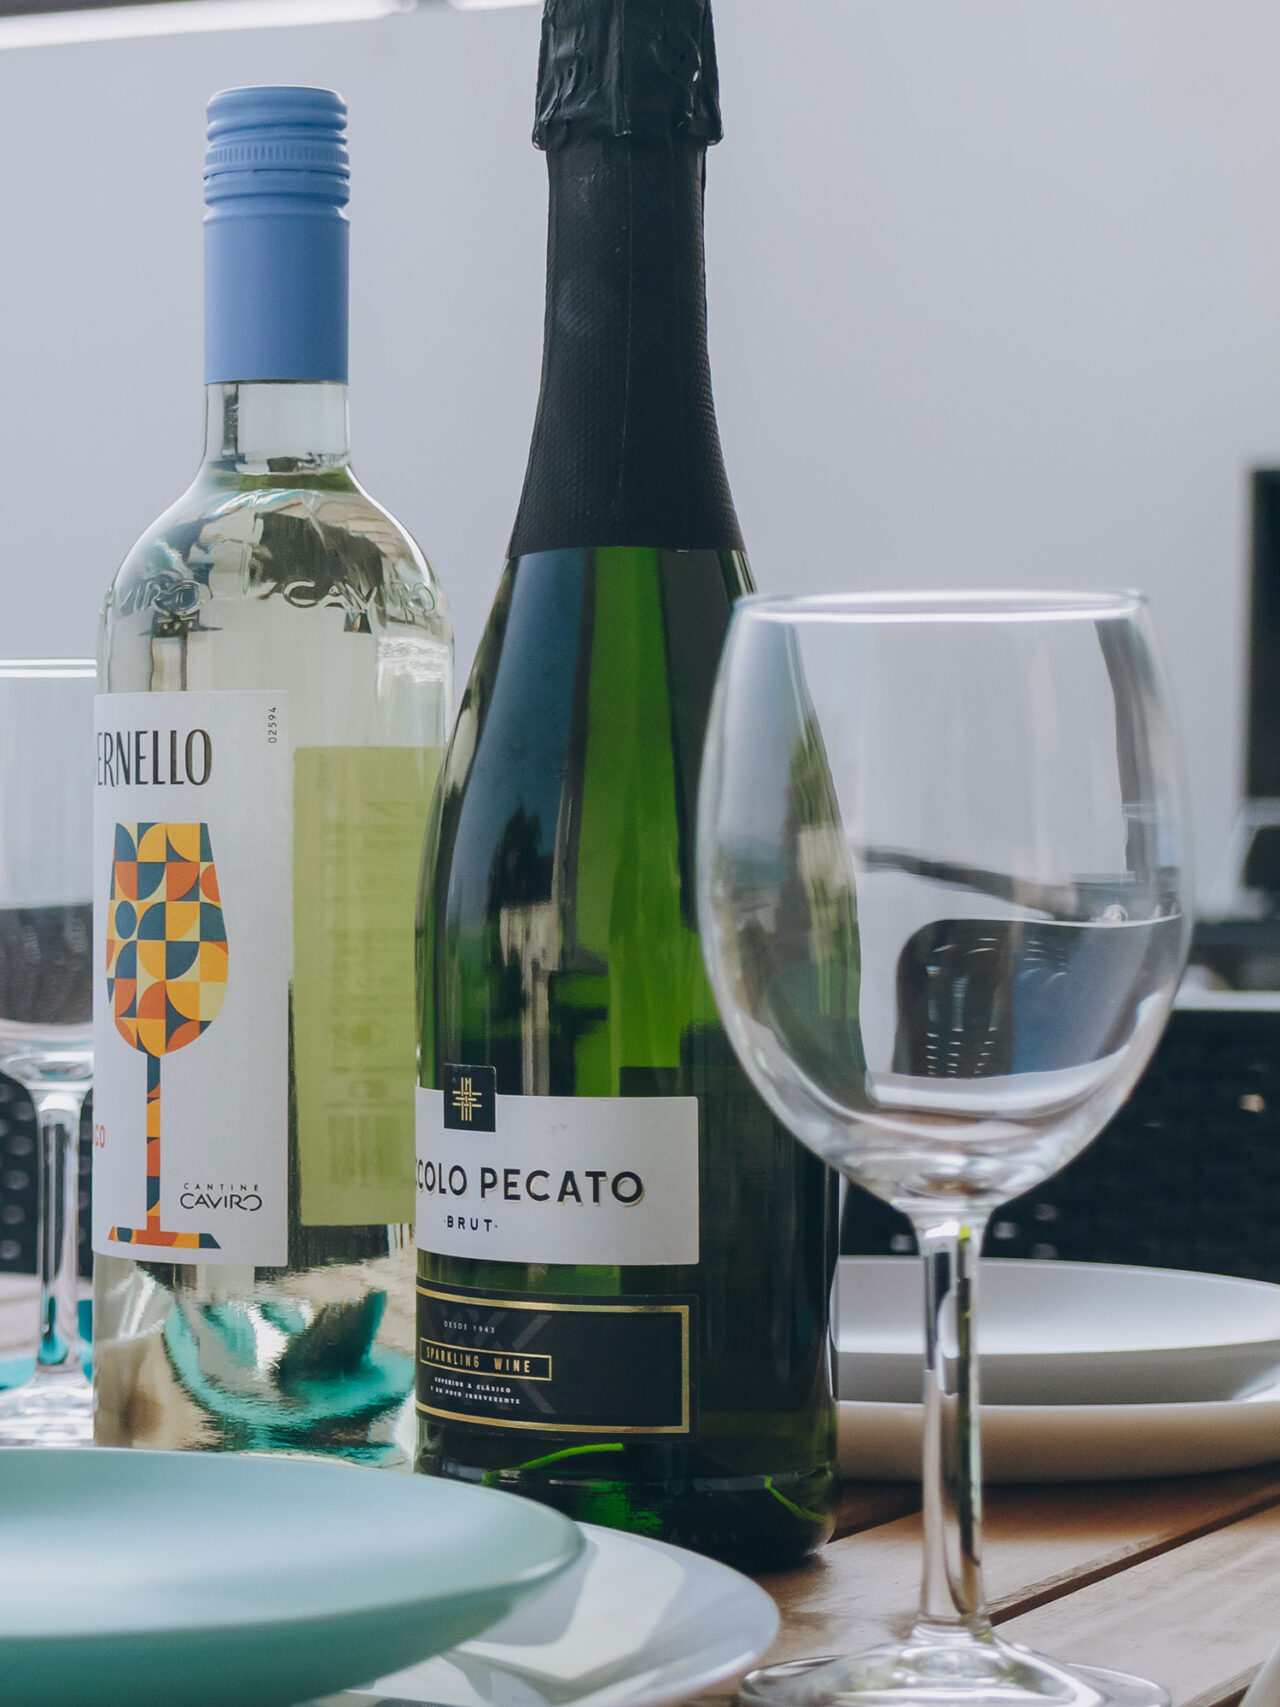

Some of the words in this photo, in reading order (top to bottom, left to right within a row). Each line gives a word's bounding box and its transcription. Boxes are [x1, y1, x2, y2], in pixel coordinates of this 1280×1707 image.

[267, 706, 277, 744] 02594
[97, 729, 212, 787] ERNELLO
[183, 1182, 260, 1192] CANTINE
[415, 1157, 467, 1197] COLO
[480, 1166, 644, 1206] PECATO
[179, 1192, 263, 1212] CAVIRO
[443, 1320, 468, 1331] DESDE
[426, 1346, 480, 1369] SPARKLING
[493, 1357, 532, 1374] WINE
